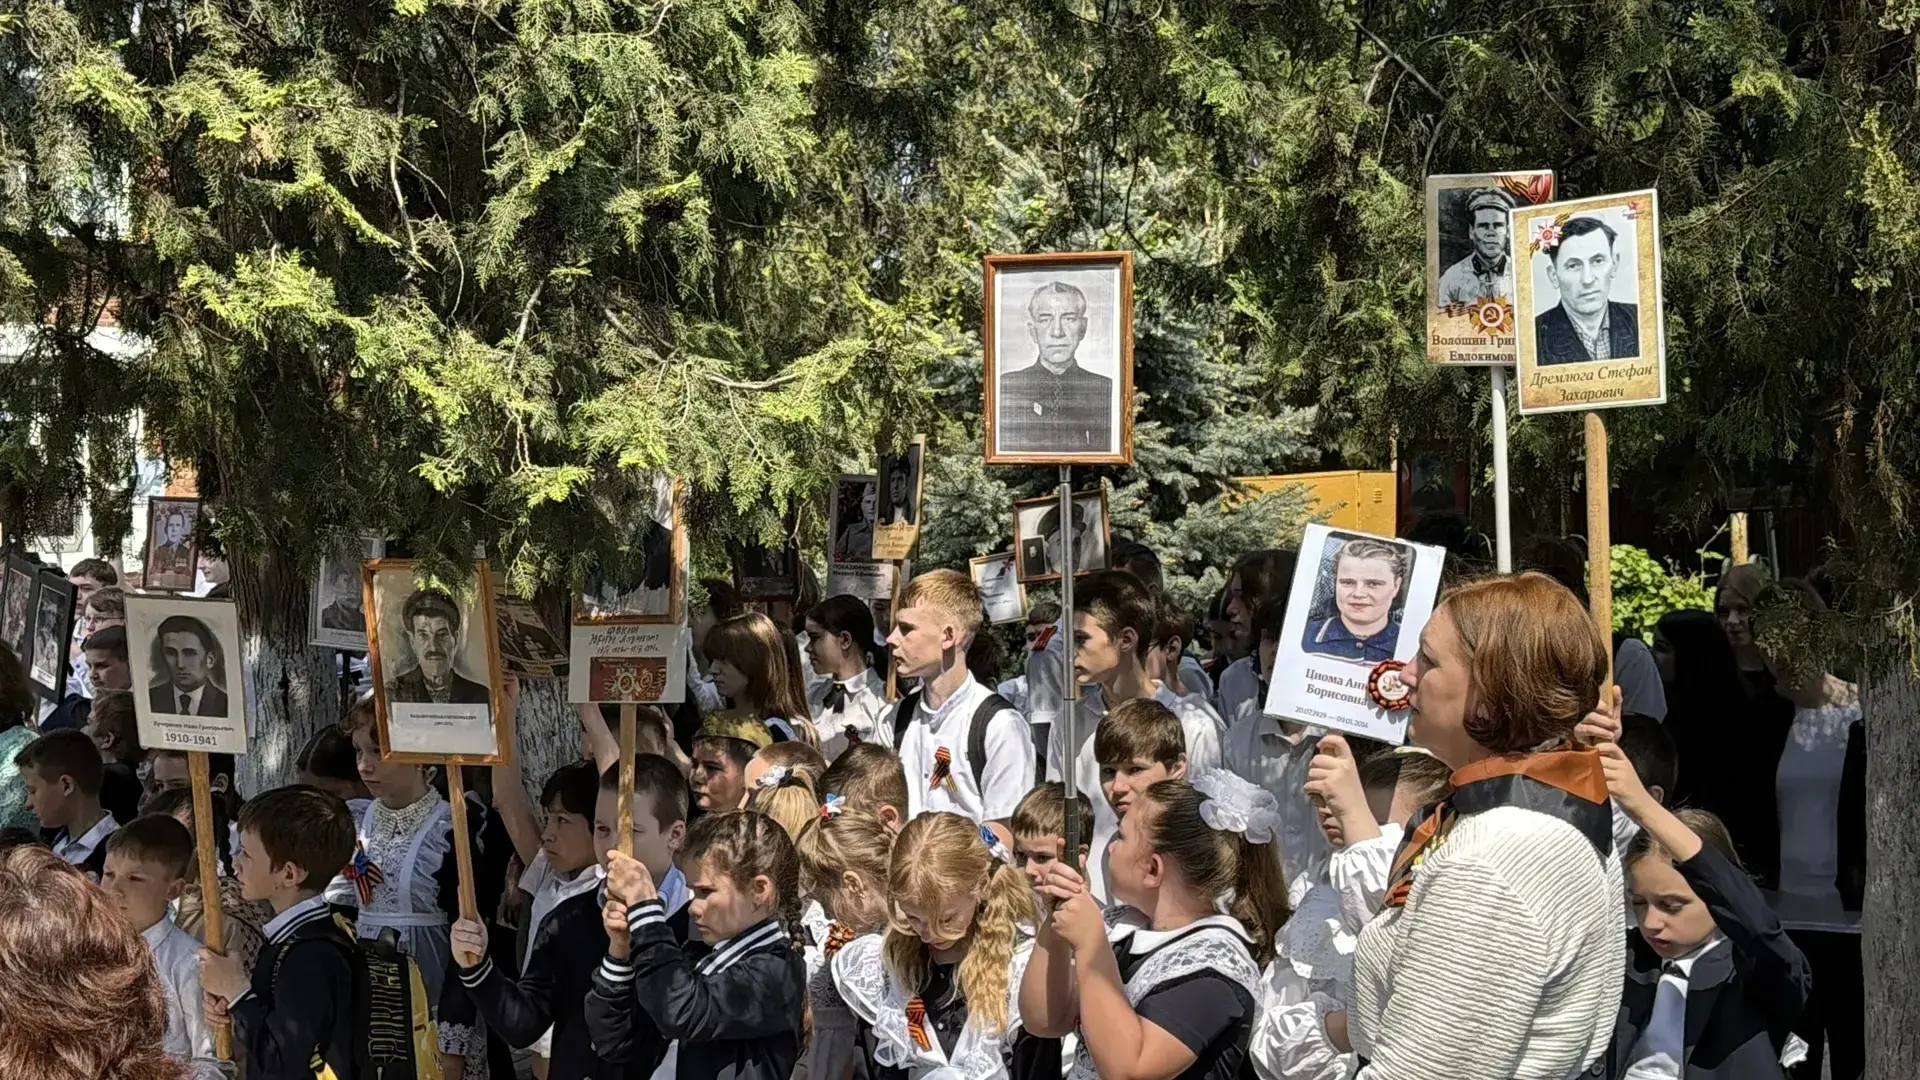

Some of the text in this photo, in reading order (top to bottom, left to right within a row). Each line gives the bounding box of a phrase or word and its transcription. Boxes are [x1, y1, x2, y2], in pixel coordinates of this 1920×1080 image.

[1432, 334, 1486, 346] Волошин
[1449, 350, 1516, 362] Евдокимов
[1530, 364, 1653, 388] Дремлюга Стефан
[1559, 387, 1625, 403] Захарович
[1306, 669, 1343, 685] Циома
[1306, 684, 1367, 706] Борисовна
[165, 733, 217, 745] 1910-1941
